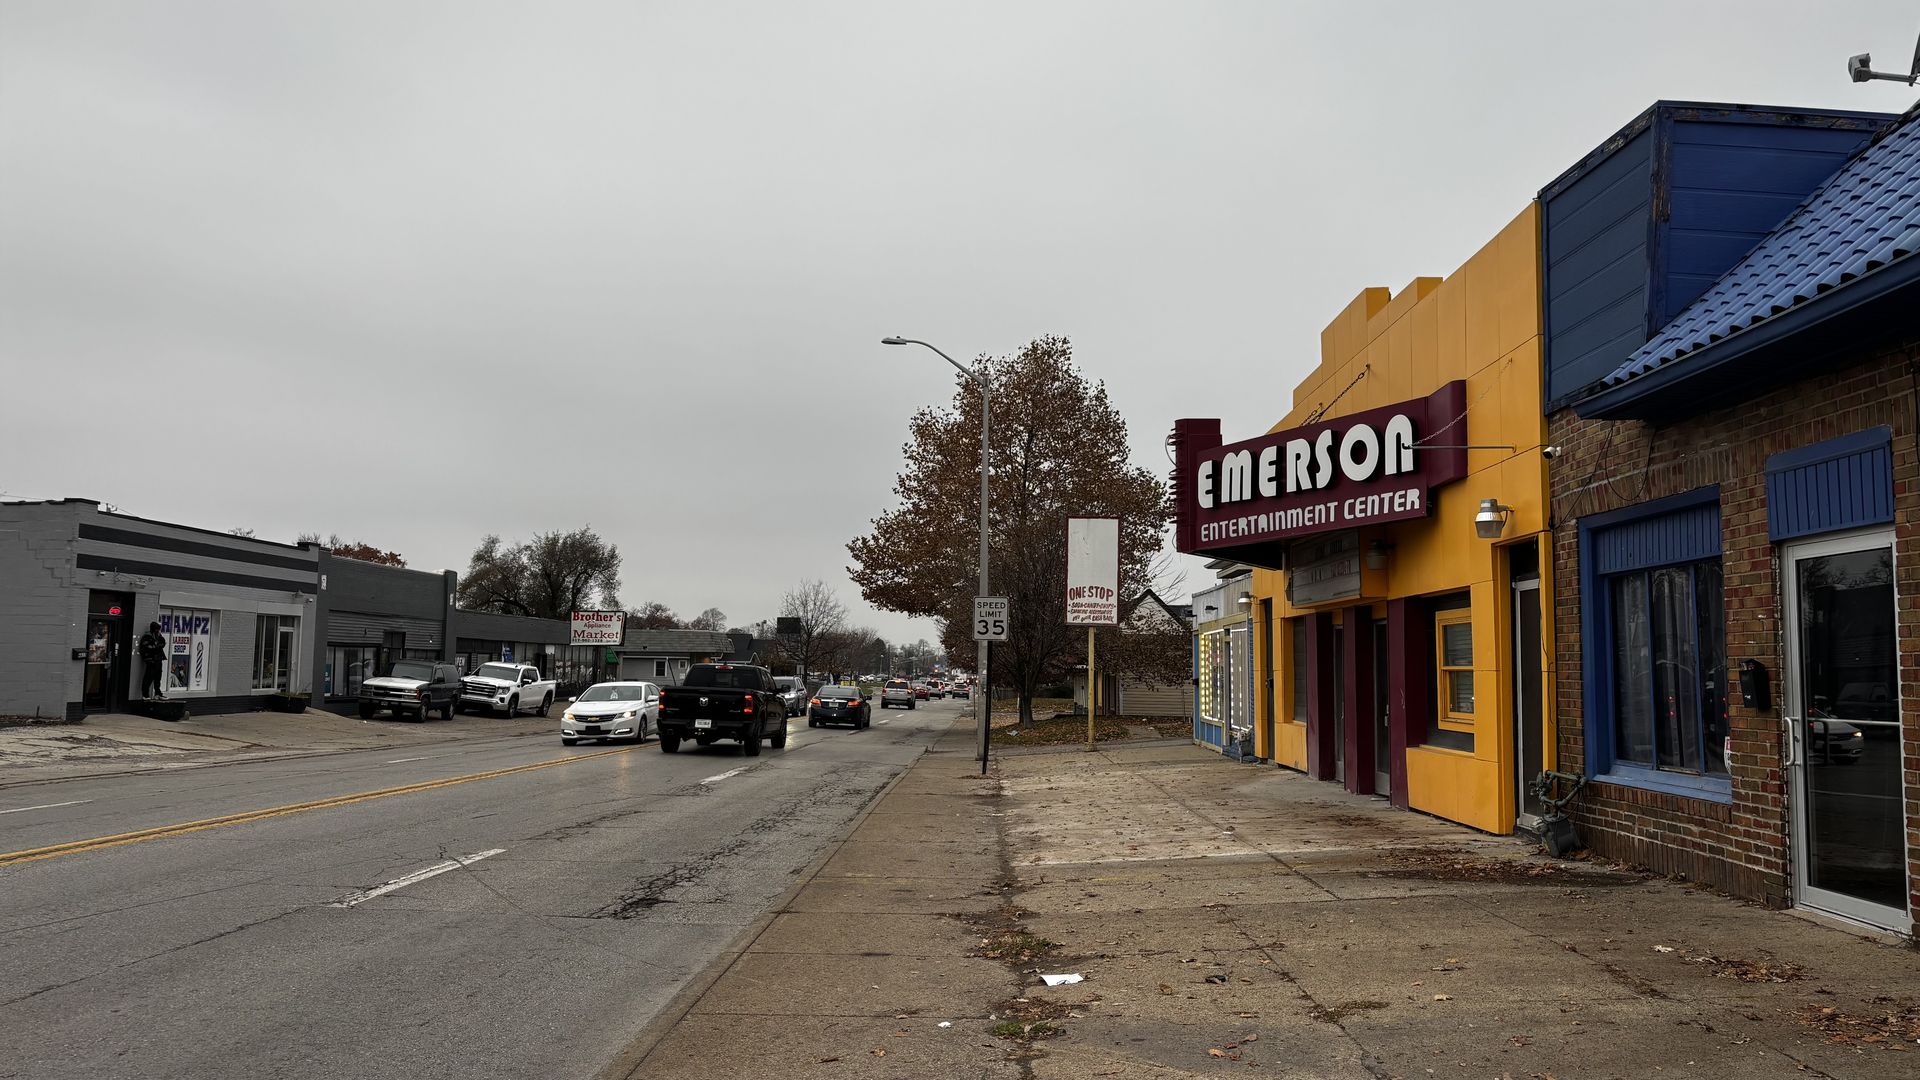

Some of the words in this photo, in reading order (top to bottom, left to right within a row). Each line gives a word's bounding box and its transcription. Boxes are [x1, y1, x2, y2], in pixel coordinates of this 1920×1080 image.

[1198, 414, 1414, 510] EMERSON
[1201, 501, 1339, 542] ENTERTAINMENT
[1343, 488, 1420, 519] CENTER
[1069, 586, 1086, 600] ONE
[1088, 586, 1114, 601] STOP
[977, 601, 1006, 609] SPEED
[572, 610, 622, 622] Brother's
[980, 610, 1002, 618] LIMIT
[158, 614, 210, 636] HAMPZ
[977, 619, 1005, 636] 35
[573, 630, 619, 640] Market
